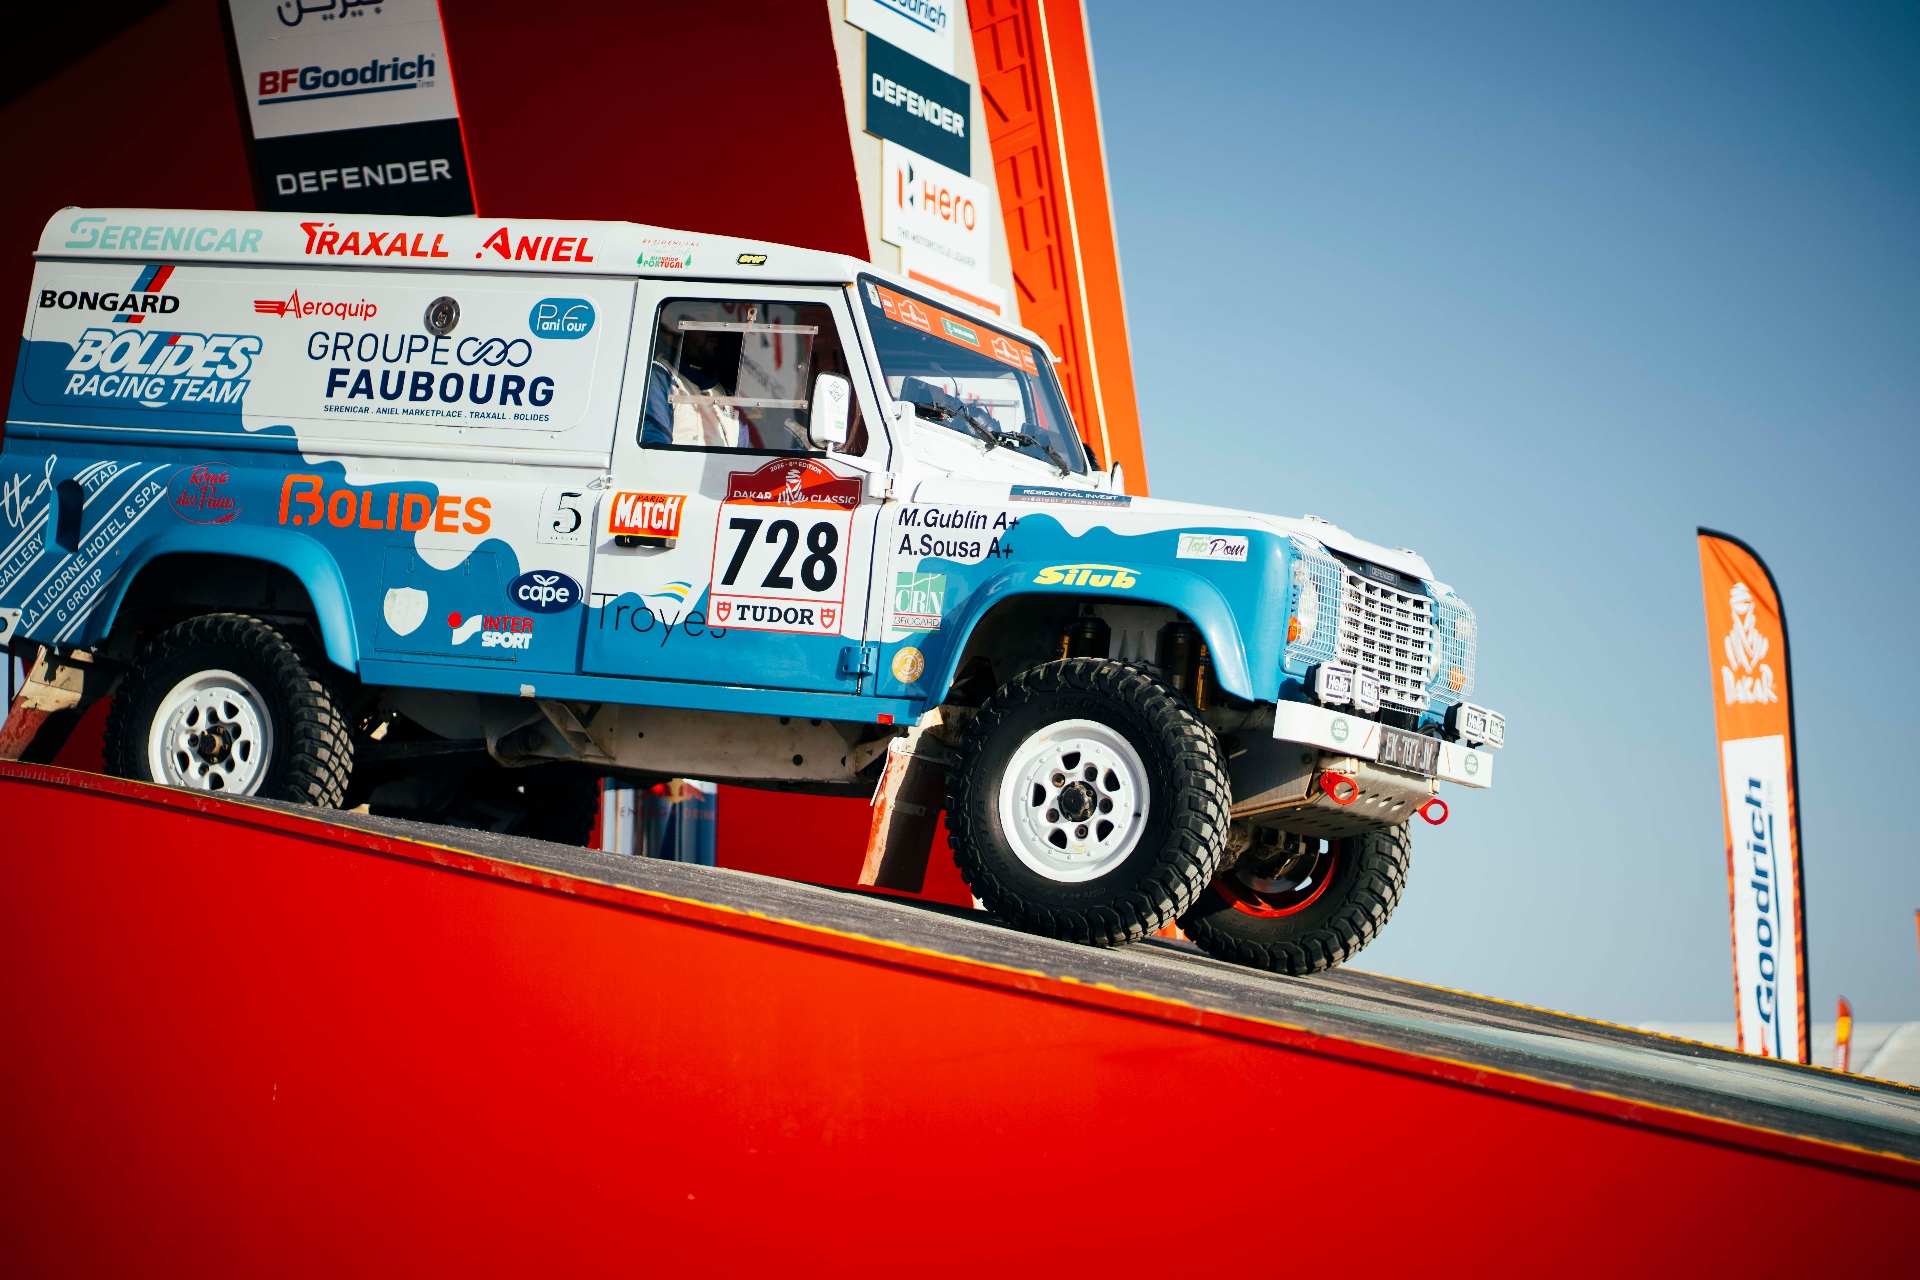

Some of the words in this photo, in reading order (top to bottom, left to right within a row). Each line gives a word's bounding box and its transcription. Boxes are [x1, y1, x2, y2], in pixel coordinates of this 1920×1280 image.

[258, 54, 436, 96] BFGoodrich
[872, 72, 965, 138] DEFENDER
[276, 158, 453, 195] DEFENDER
[923, 179, 976, 232] Hero
[65, 216, 264, 253] SERENICAR
[299, 222, 449, 258] TRAXALL
[475, 226, 594, 263] ANIEL
[643, 260, 683, 269] PORTUGAL
[39, 289, 180, 314] BONGARD
[279, 288, 378, 321] Aeroquip
[307, 331, 451, 365] GROUPE
[63, 373, 166, 400] RACING
[169, 378, 247, 404] TEAM
[325, 367, 554, 407] FAUBOURG
[323, 404, 370, 414] SERENICAR
[375, 407, 400, 416] ANIEL
[401, 408, 463, 418] MARKETPLACE
[469, 411, 507, 420] TRAXALL
[513, 413, 550, 422] BOLIDES
[769, 462, 785, 473] 2026
[798, 461, 823, 475] EDITION
[176, 488, 198, 507] des
[278, 473, 492, 535] BOLIDES
[636, 495, 666, 503] PARIS
[732, 490, 772, 500] DAKAR
[810, 494, 856, 505] CLASSIC
[1023, 489, 1081, 498] RESIDENTIAL
[1085, 493, 1119, 501] INVEST
[552, 492, 583, 534] 5
[614, 493, 681, 531] MATCH
[898, 507, 988, 530] M.Gublin
[992, 510, 1021, 531] A+
[20, 608, 40, 629] LA
[37, 554, 89, 609] LICORNE
[86, 519, 126, 562] HOTEL
[124, 505, 136, 519] &
[134, 481, 162, 509] SPA
[720, 517, 839, 593] 728
[898, 533, 981, 559] A.Sousa
[987, 538, 1014, 559] A+
[66, 568, 103, 611] GROUP
[1033, 565, 1138, 589] Silub
[1371, 566, 1395, 582] DEFENDER
[518, 583, 570, 608] cape
[895, 589, 944, 614] CRN
[483, 614, 534, 634] INTER
[736, 604, 815, 626] TUDOR
[481, 632, 533, 650] SPORT
[1722, 664, 1779, 706] DAKAR
